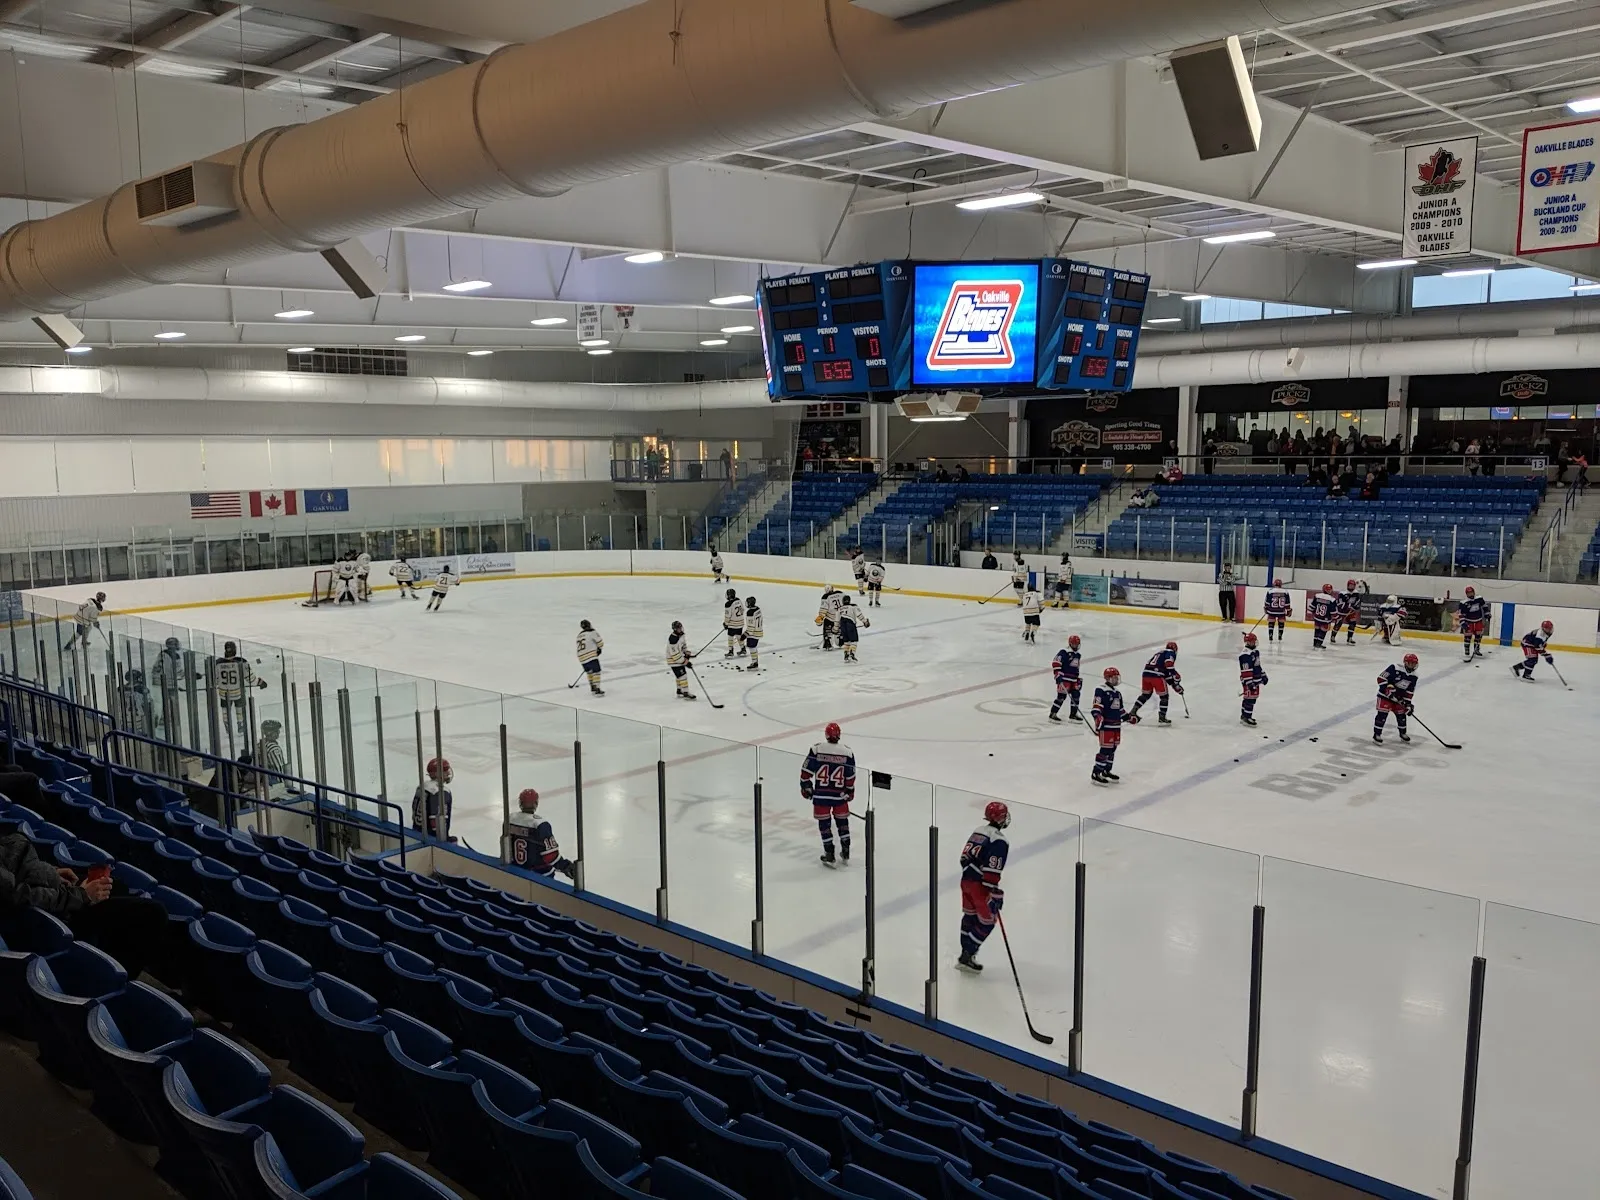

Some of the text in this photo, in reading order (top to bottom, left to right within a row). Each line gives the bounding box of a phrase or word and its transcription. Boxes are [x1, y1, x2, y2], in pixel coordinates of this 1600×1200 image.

[1534, 138, 1594, 154] OAKVILLE BLADES
[1418, 198, 1457, 210] JUNIOR A
[1544, 194, 1576, 205] JUNIOR A
[1412, 208, 1461, 220] CHAMPIONS
[1534, 203, 1586, 216] BUCKLAND CUP
[1411, 222, 1431, 231] 2009
[1441, 218, 1463, 228] 2010
[1539, 215, 1579, 226] CHAMPIONS
[1418, 231, 1454, 242] OAKVILLE
[1540, 226, 1555, 236] 2009
[1561, 225, 1576, 234] 2010
[1420, 242, 1450, 252] BLADES
[825, 267, 875, 280] PLAYER PENALTY
[1070, 264, 1105, 276] PLAYER PENALTY
[766, 276, 810, 288] PLAYER PENALTY
[1114, 272, 1146, 283] PLAYER PENALTY
[982, 290, 1010, 302] Oakville
[817, 327, 838, 335] PERIOD
[852, 326, 879, 336] VISITOR
[1067, 323, 1084, 332] HOME
[783, 334, 801, 342] HOME
[869, 338, 879, 356] 0
[796, 345, 805, 362] 0
[1508, 382, 1543, 391] PUCKZ
[1105, 422, 1127, 431] Sporting
[1058, 431, 1094, 442] PUCKZ
[440, 576, 448, 585] 21
[576, 638, 586, 652] 26
[221, 670, 237, 685] 96
[816, 764, 844, 787] 44
[989, 855, 1003, 869] 91
